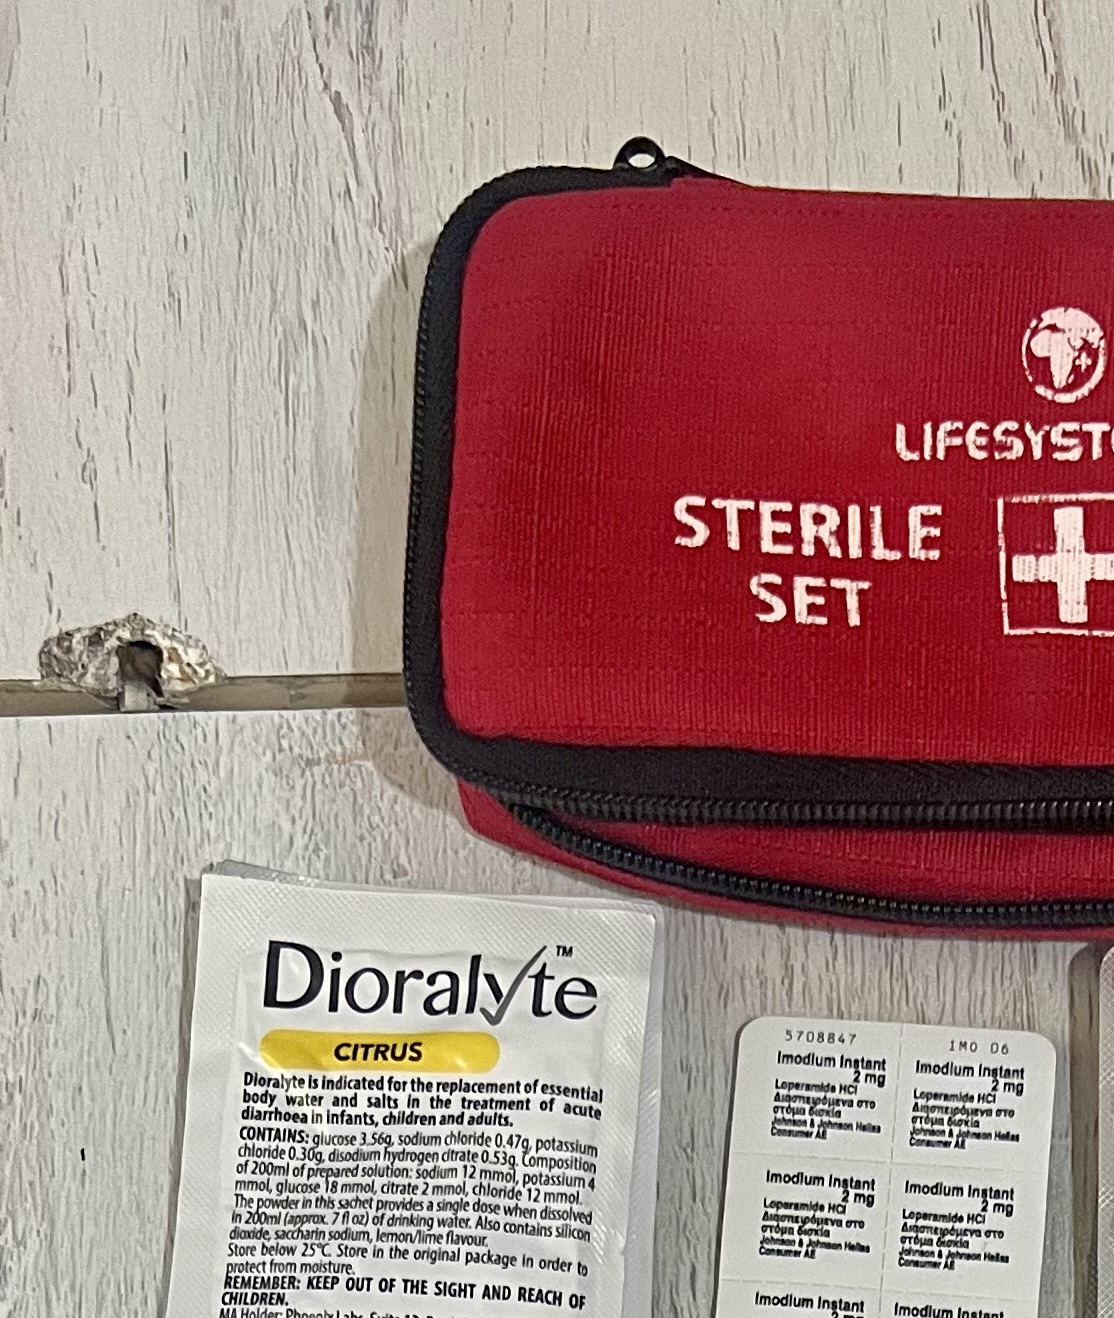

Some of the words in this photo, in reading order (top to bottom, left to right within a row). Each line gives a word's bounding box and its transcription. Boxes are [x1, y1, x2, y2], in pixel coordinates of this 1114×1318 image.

[674, 495, 942, 561] STERILE
[749, 574, 871, 627] SET
[262, 941, 598, 1025] Dioralyte
[785, 1030, 856, 1045] 5708847
[334, 1042, 423, 1062] CITRUS
[778, 1050, 836, 1067] Imodium
[840, 1055, 886, 1071] Instant
[853, 1071, 860, 1083] 2
[865, 1073, 885, 1088] mg
[916, 1060, 974, 1076] Imodium
[979, 1064, 1024, 1080] Instant
[244, 1072, 305, 1092] Dioralyte
[308, 1074, 318, 1089] is
[322, 1075, 384, 1090] indicated
[387, 1076, 407, 1092] for
[411, 1077, 433, 1092] the
[436, 1079, 521, 1095] replacement
[524, 1079, 539, 1094] of
[541, 1083, 603, 1103] essential
[991, 1079, 999, 1091] 2
[1003, 1082, 1024, 1096] mg
[243, 1089, 276, 1107] body
[286, 1094, 323, 1107] water
[332, 1092, 358, 1107] and
[367, 1094, 398, 1108] salts
[407, 1094, 420, 1109] in
[430, 1097, 451, 1109] the
[462, 1097, 530, 1111] treatment
[540, 1098, 555, 1112] of
[563, 1103, 601, 1120] acute
[240, 1126, 309, 1144] CONTAINS:
[222, 1292, 288, 1306] CHILDREN.
[224, 1275, 300, 1290] REMEMBER:
[307, 1276, 339, 1290] KEEP
[346, 1277, 373, 1291] OUT
[379, 1278, 396, 1293] OF
[402, 1279, 428, 1295] THE
[434, 1281, 476, 1298] SIGHT
[482, 1285, 511, 1300] AND
[518, 1287, 562, 1306] REACH
[569, 1294, 586, 1310] OF
